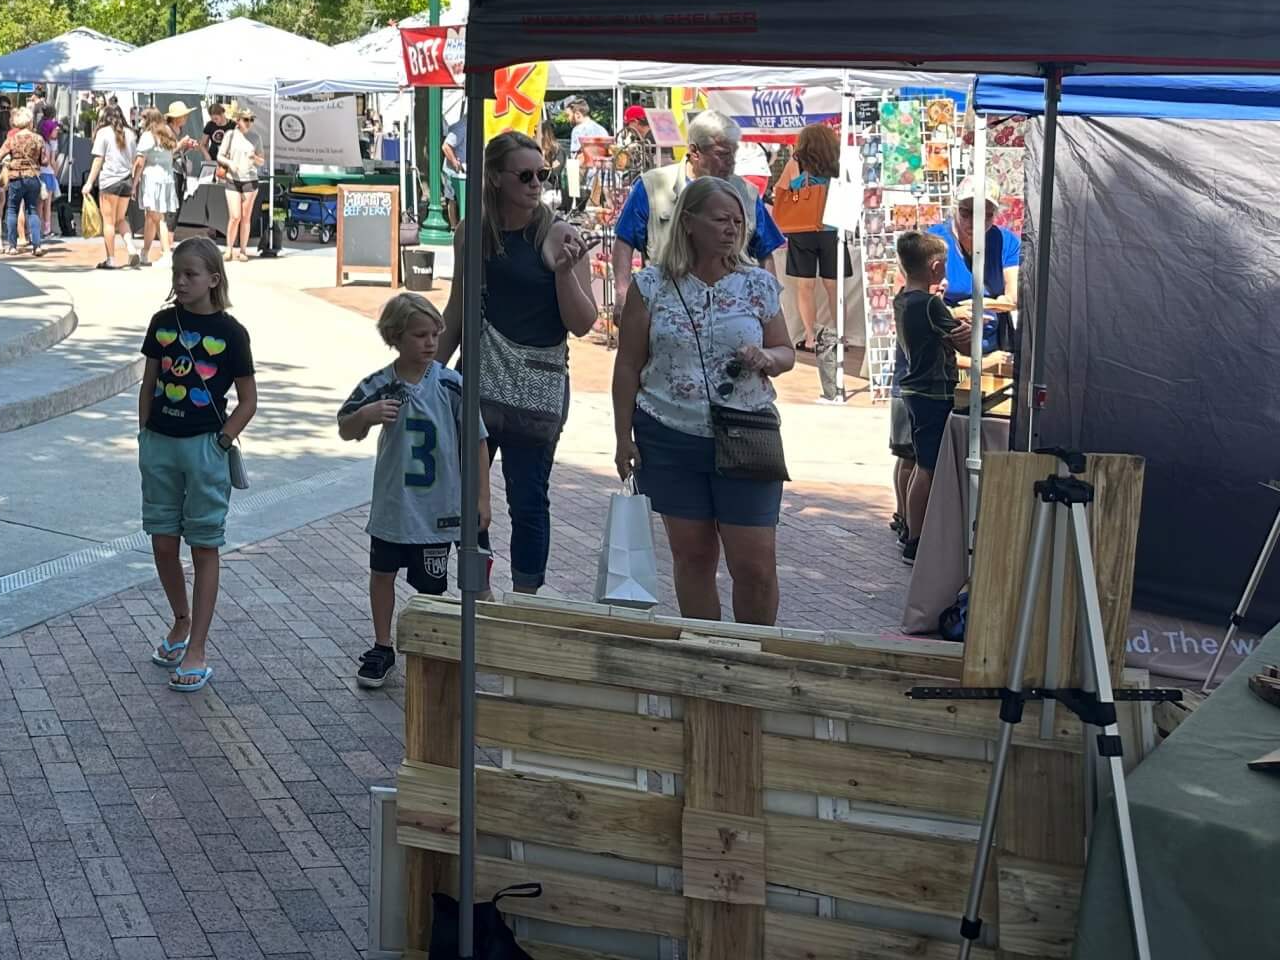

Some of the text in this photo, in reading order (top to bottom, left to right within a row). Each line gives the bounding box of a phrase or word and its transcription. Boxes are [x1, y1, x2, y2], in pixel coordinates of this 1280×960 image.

[663, 11, 758, 26] SHELTER
[408, 37, 442, 76] BEEF
[751, 89, 807, 116] MAMA'S
[755, 116, 807, 128] BEEF JERKY
[362, 206, 392, 217] JERKY
[404, 416, 438, 487] 3
[1161, 630, 1219, 655] The
